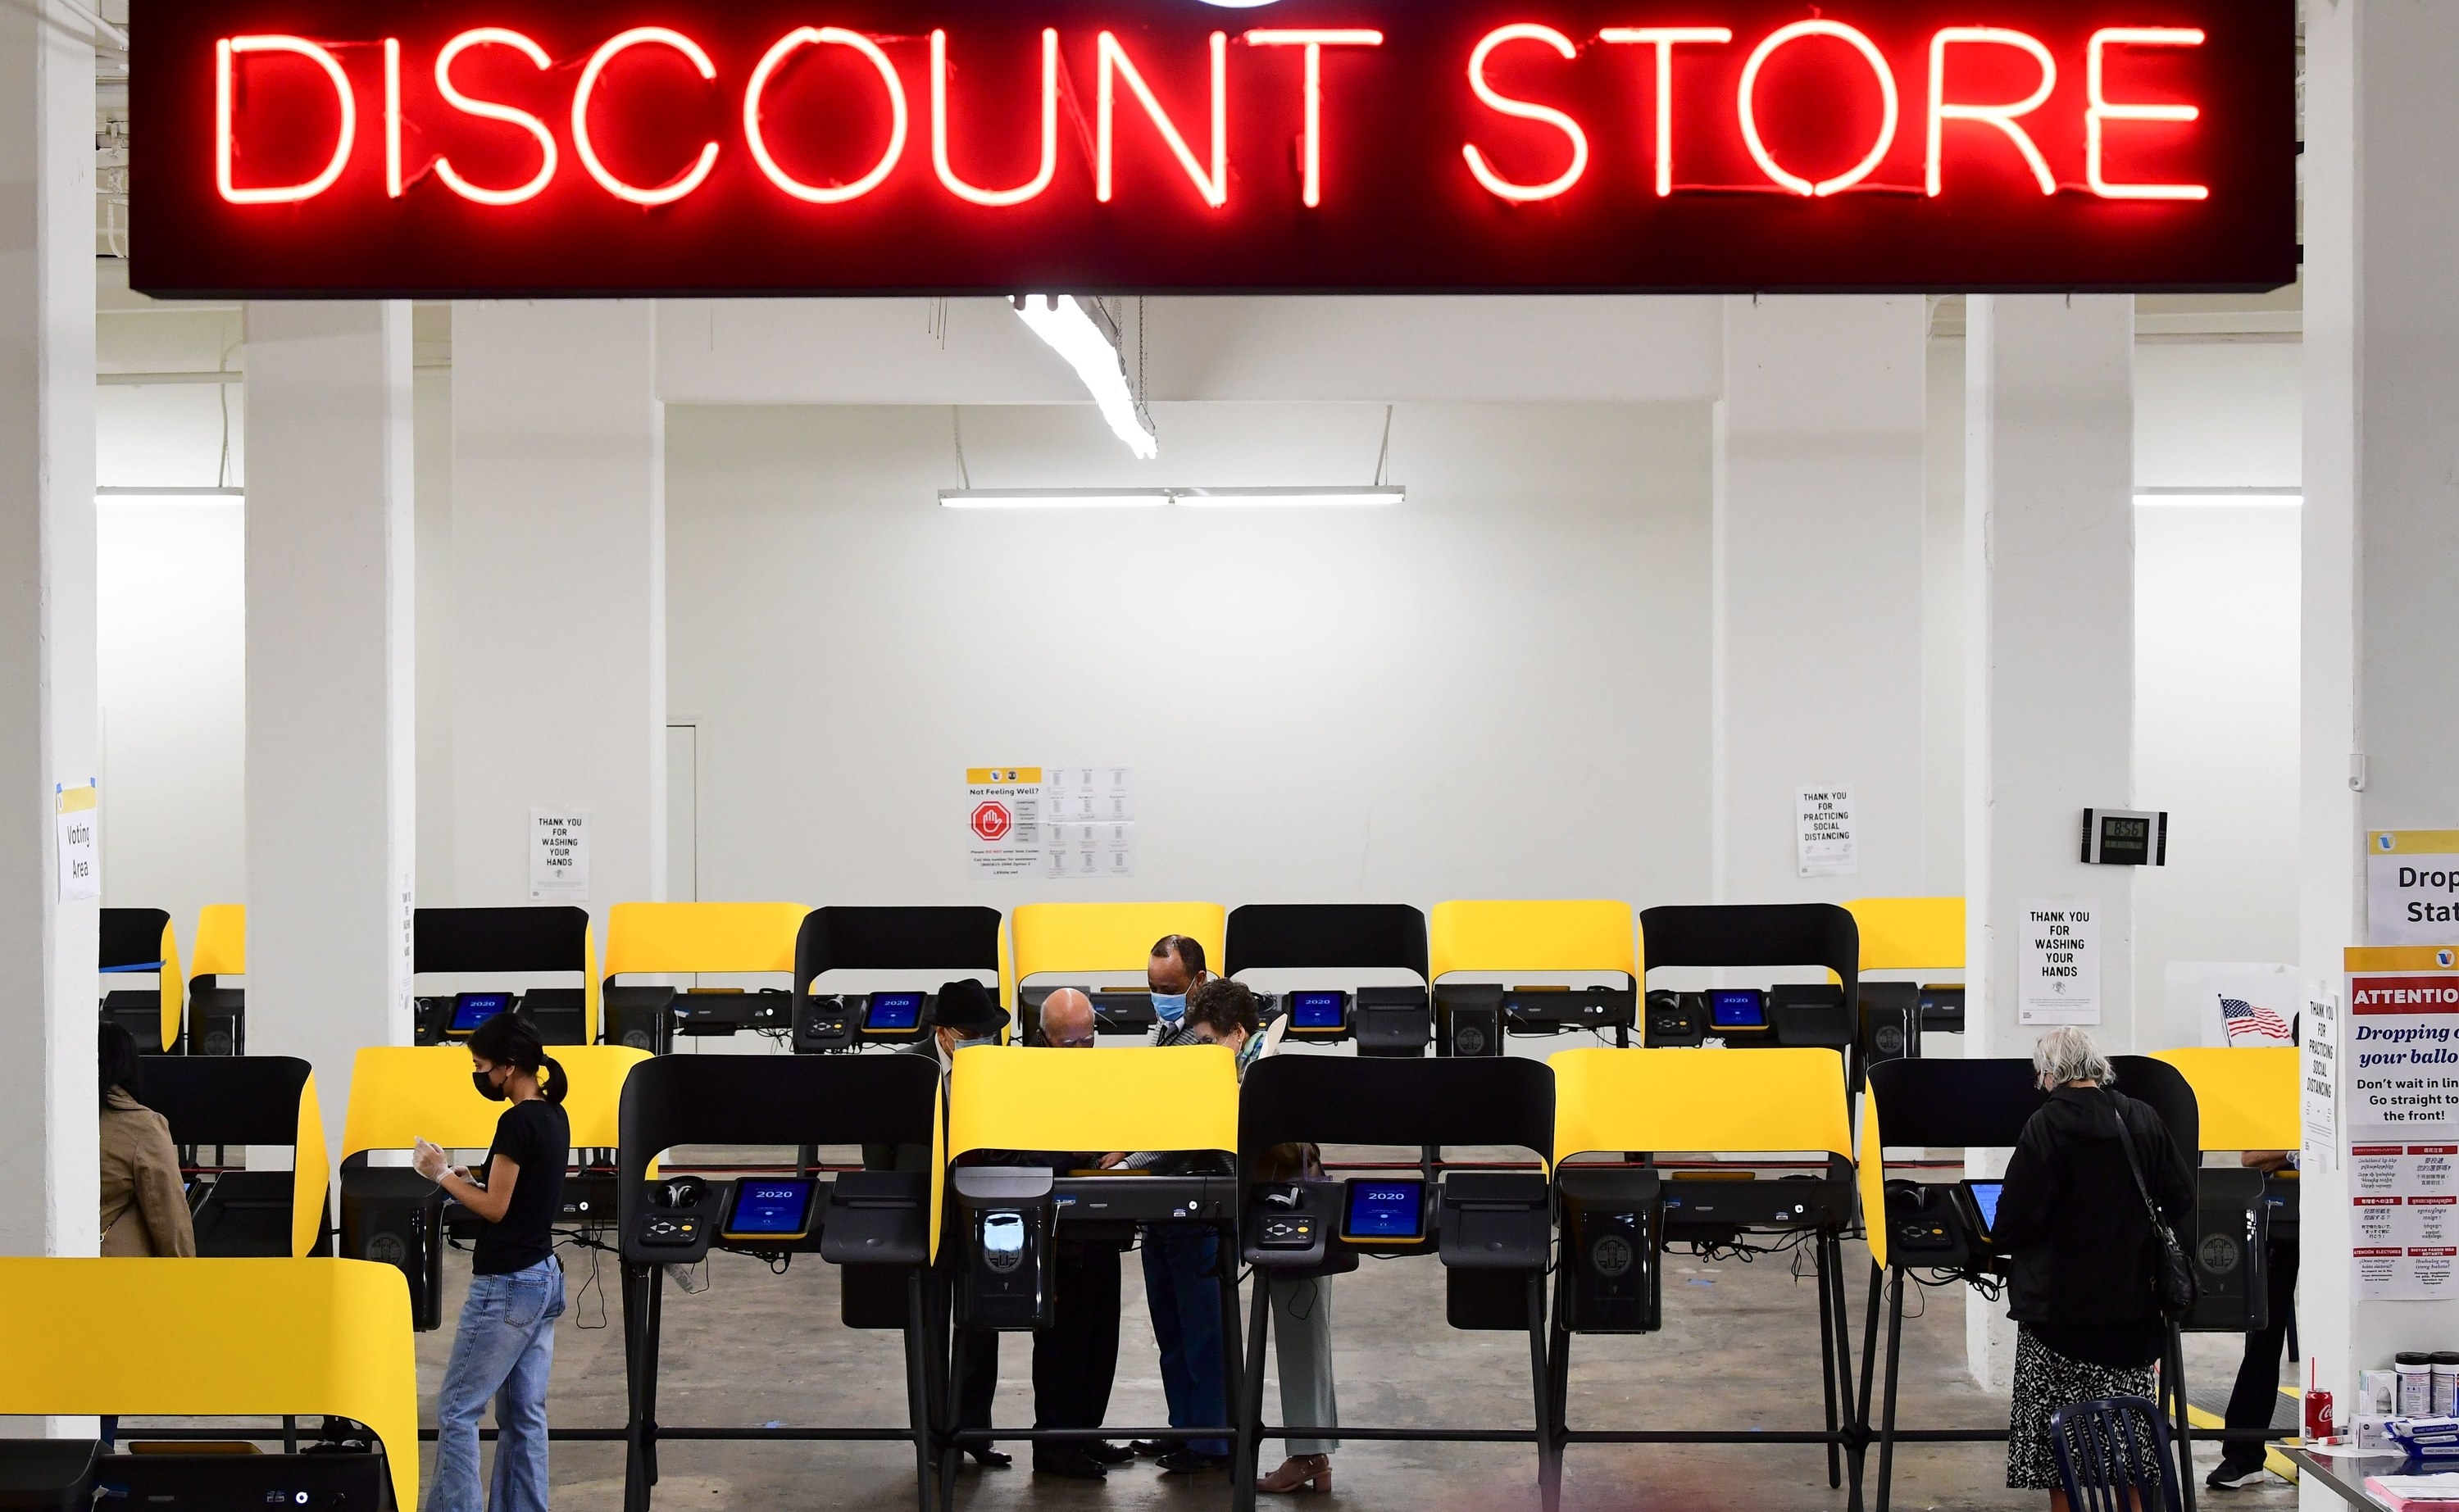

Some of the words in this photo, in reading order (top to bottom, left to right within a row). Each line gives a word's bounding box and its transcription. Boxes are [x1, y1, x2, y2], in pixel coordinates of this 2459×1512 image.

[217, 27, 1382, 207] DISCOUNT
[1463, 20, 2207, 200] STORE
[986, 788, 1016, 797] Feeling
[1803, 792, 1829, 801] THANK
[1832, 792, 1847, 800] YOU
[1818, 802, 1833, 810] FOR
[539, 818, 564, 826] THANK
[1803, 811, 1848, 821] PRACTICING
[1813, 822, 1839, 831] SOCIAL
[66, 823, 90, 847] Voting
[1804, 831, 1850, 841] DISTANCING
[73, 860, 89, 879] Area
[2399, 867, 2459, 893] Drop
[2030, 911, 2065, 922] THANK
[2069, 911, 2090, 922] YOU
[2407, 902, 2459, 922] Stat
[2049, 925, 2070, 936] FOR
[2034, 939, 2084, 950] WASHING
[2046, 953, 2074, 963] YOUR
[2042, 967, 2078, 977] HANDS
[2353, 988, 2458, 1005] ATTENTIO
[2310, 1001, 2325, 1019] THANK
[2325, 1005, 2334, 1021] YOU
[2317, 1022, 2326, 1038] FOR
[2356, 1024, 2450, 1042] Dropping
[2308, 1038, 2334, 1060] PRACTICING
[2359, 1052, 2407, 1068] your
[2411, 1048, 2458, 1064] ballo
[2312, 1059, 2327, 1078] SOCIAL
[2307, 1077, 2332, 1098] DISTANCING
[2395, 1078, 2424, 1088] wait
[2427, 1078, 2439, 1088] in
[2443, 1078, 2459, 1087] lin
[2369, 1095, 2387, 1106] Go
[2390, 1093, 2442, 1107] straight
[2445, 1095, 2459, 1104] to
[2384, 1111, 2405, 1121] the
[2408, 1110, 2444, 1120] front!
